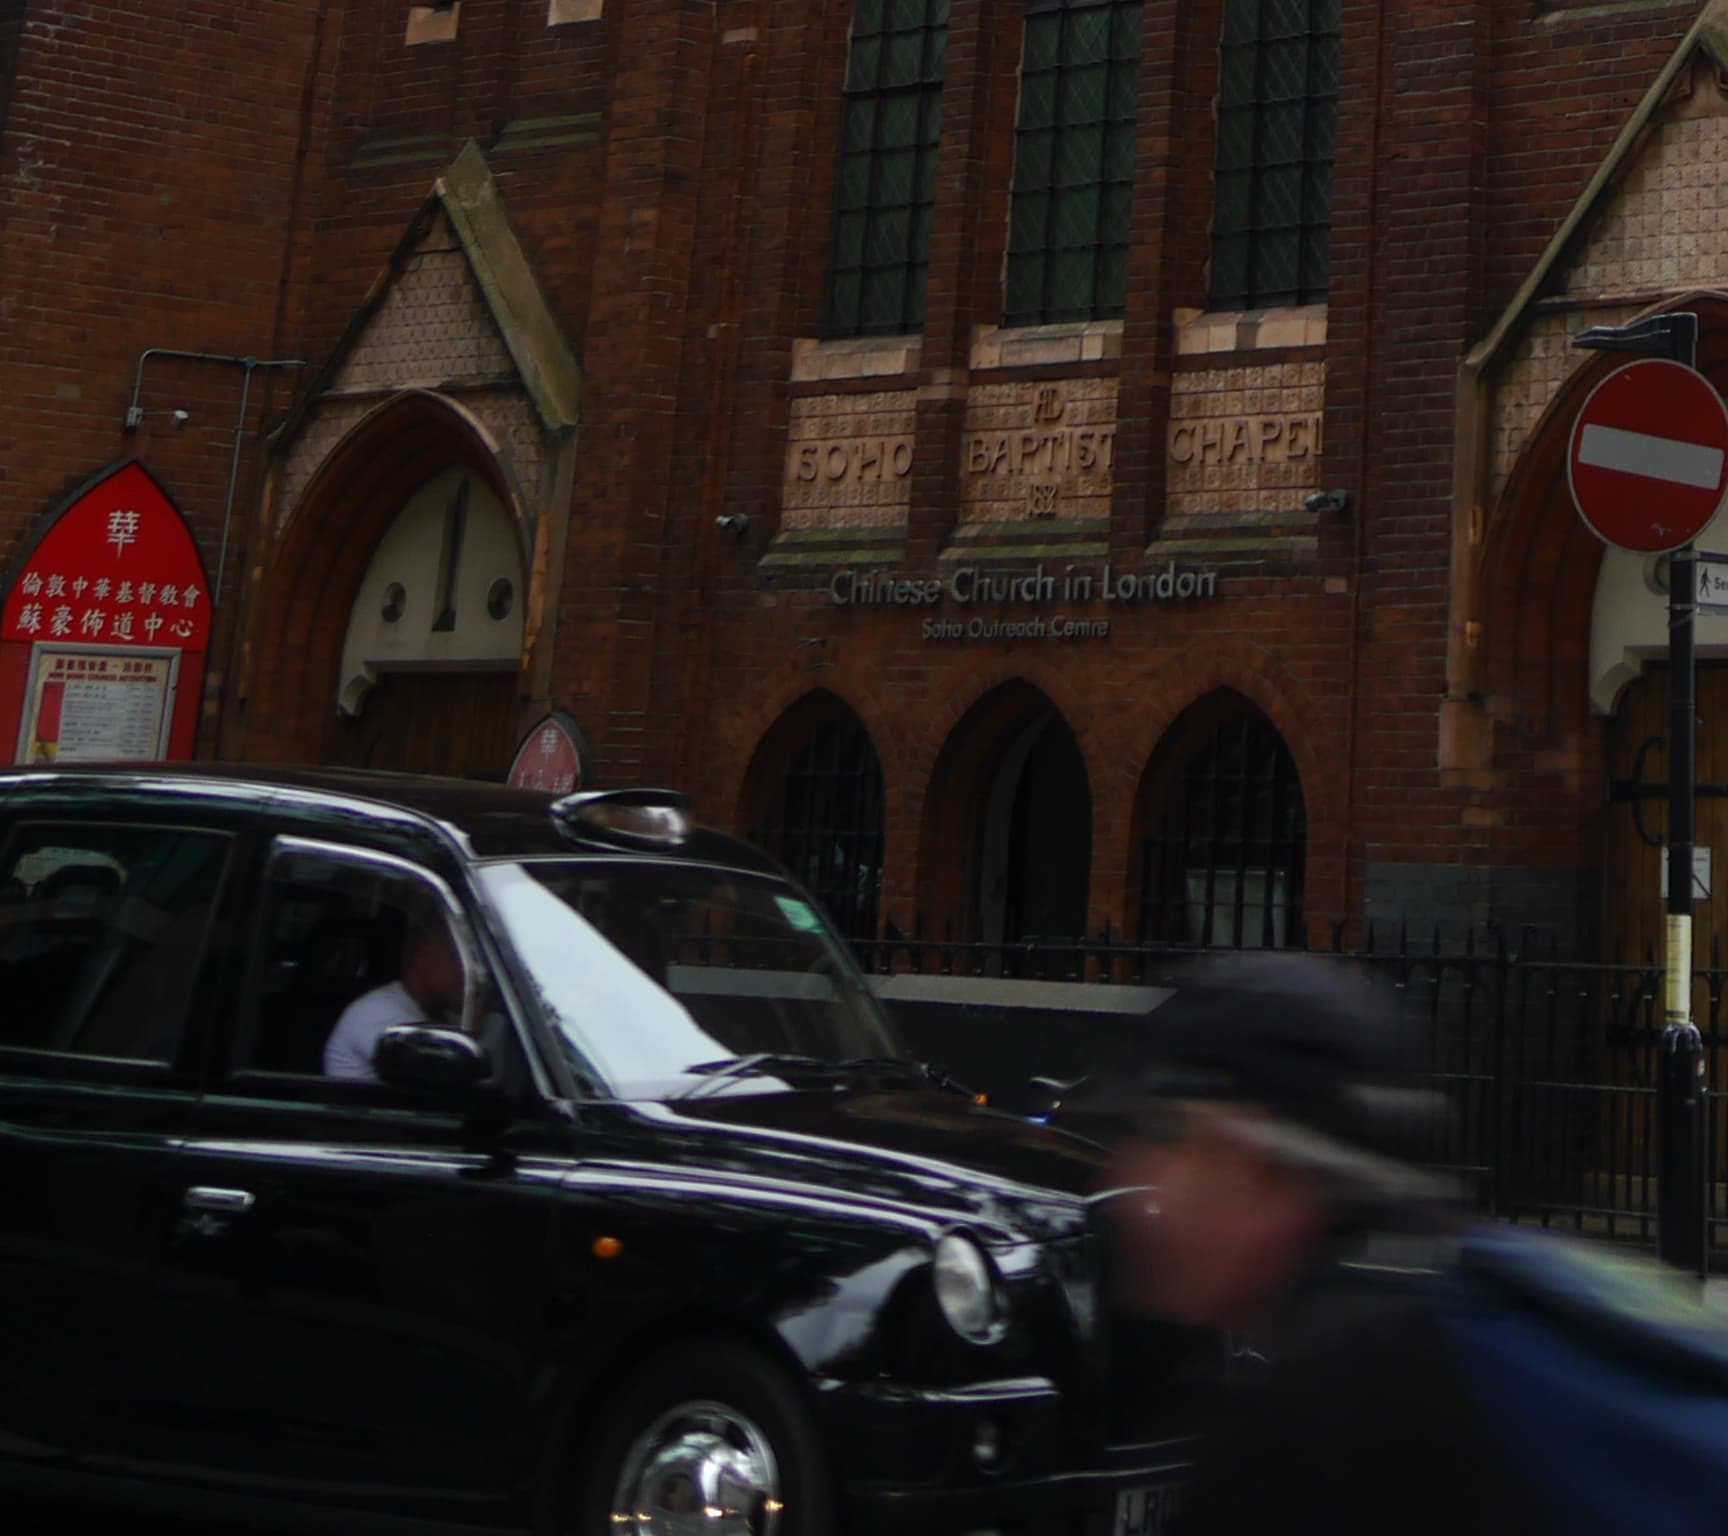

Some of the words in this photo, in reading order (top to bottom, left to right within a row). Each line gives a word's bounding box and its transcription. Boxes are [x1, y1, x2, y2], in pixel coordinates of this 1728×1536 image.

[796, 441, 914, 483] SOHO
[967, 430, 1117, 476] BAPTIST
[106, 509, 143, 561] 華
[22, 571, 202, 609] 倫敦中華基督教會
[830, 569, 941, 605] Chinese
[951, 563, 1053, 604] Church
[1064, 565, 1090, 600] in
[1102, 560, 1217, 601] London
[17, 602, 194, 643] 蘇豪佈道中心
[922, 616, 961, 640] Soho
[968, 616, 1045, 639] Outreach
[1050, 615, 1110, 639] Centre
